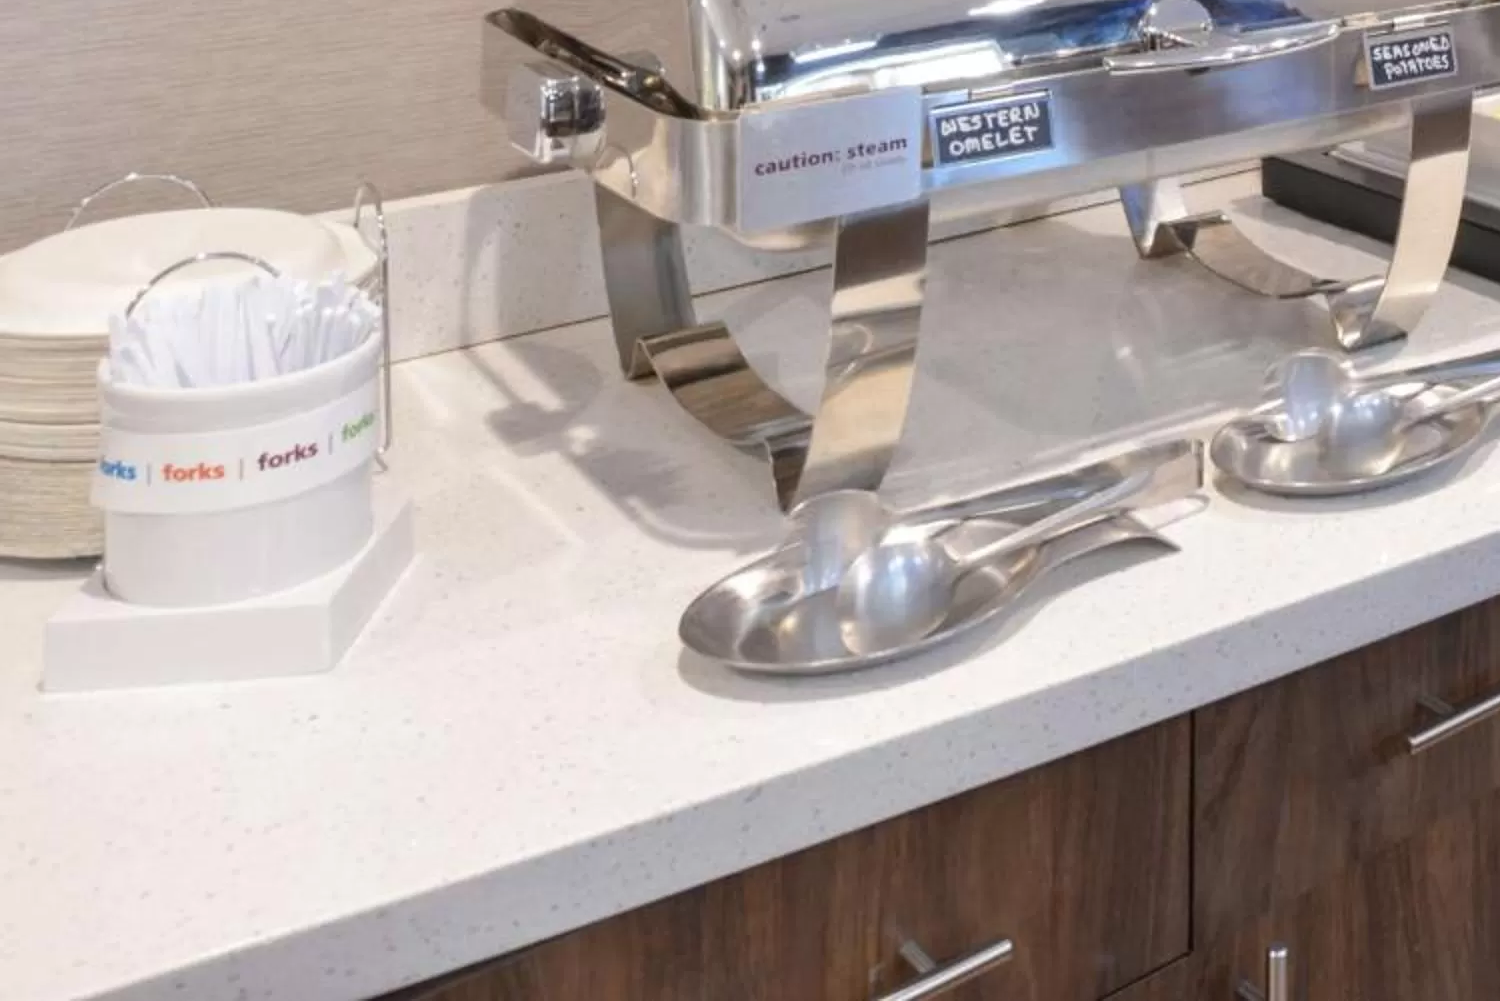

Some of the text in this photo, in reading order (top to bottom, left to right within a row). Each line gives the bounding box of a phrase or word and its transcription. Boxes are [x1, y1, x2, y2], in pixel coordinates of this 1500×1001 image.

[1373, 34, 1451, 62] SEASONED
[941, 101, 1041, 137] WESTERN
[754, 150, 842, 177] caution:
[847, 137, 908, 161] steam
[949, 125, 1040, 156] OMELET
[100, 456, 137, 481] orks
[161, 462, 226, 482] forks
[257, 442, 319, 472] forks
